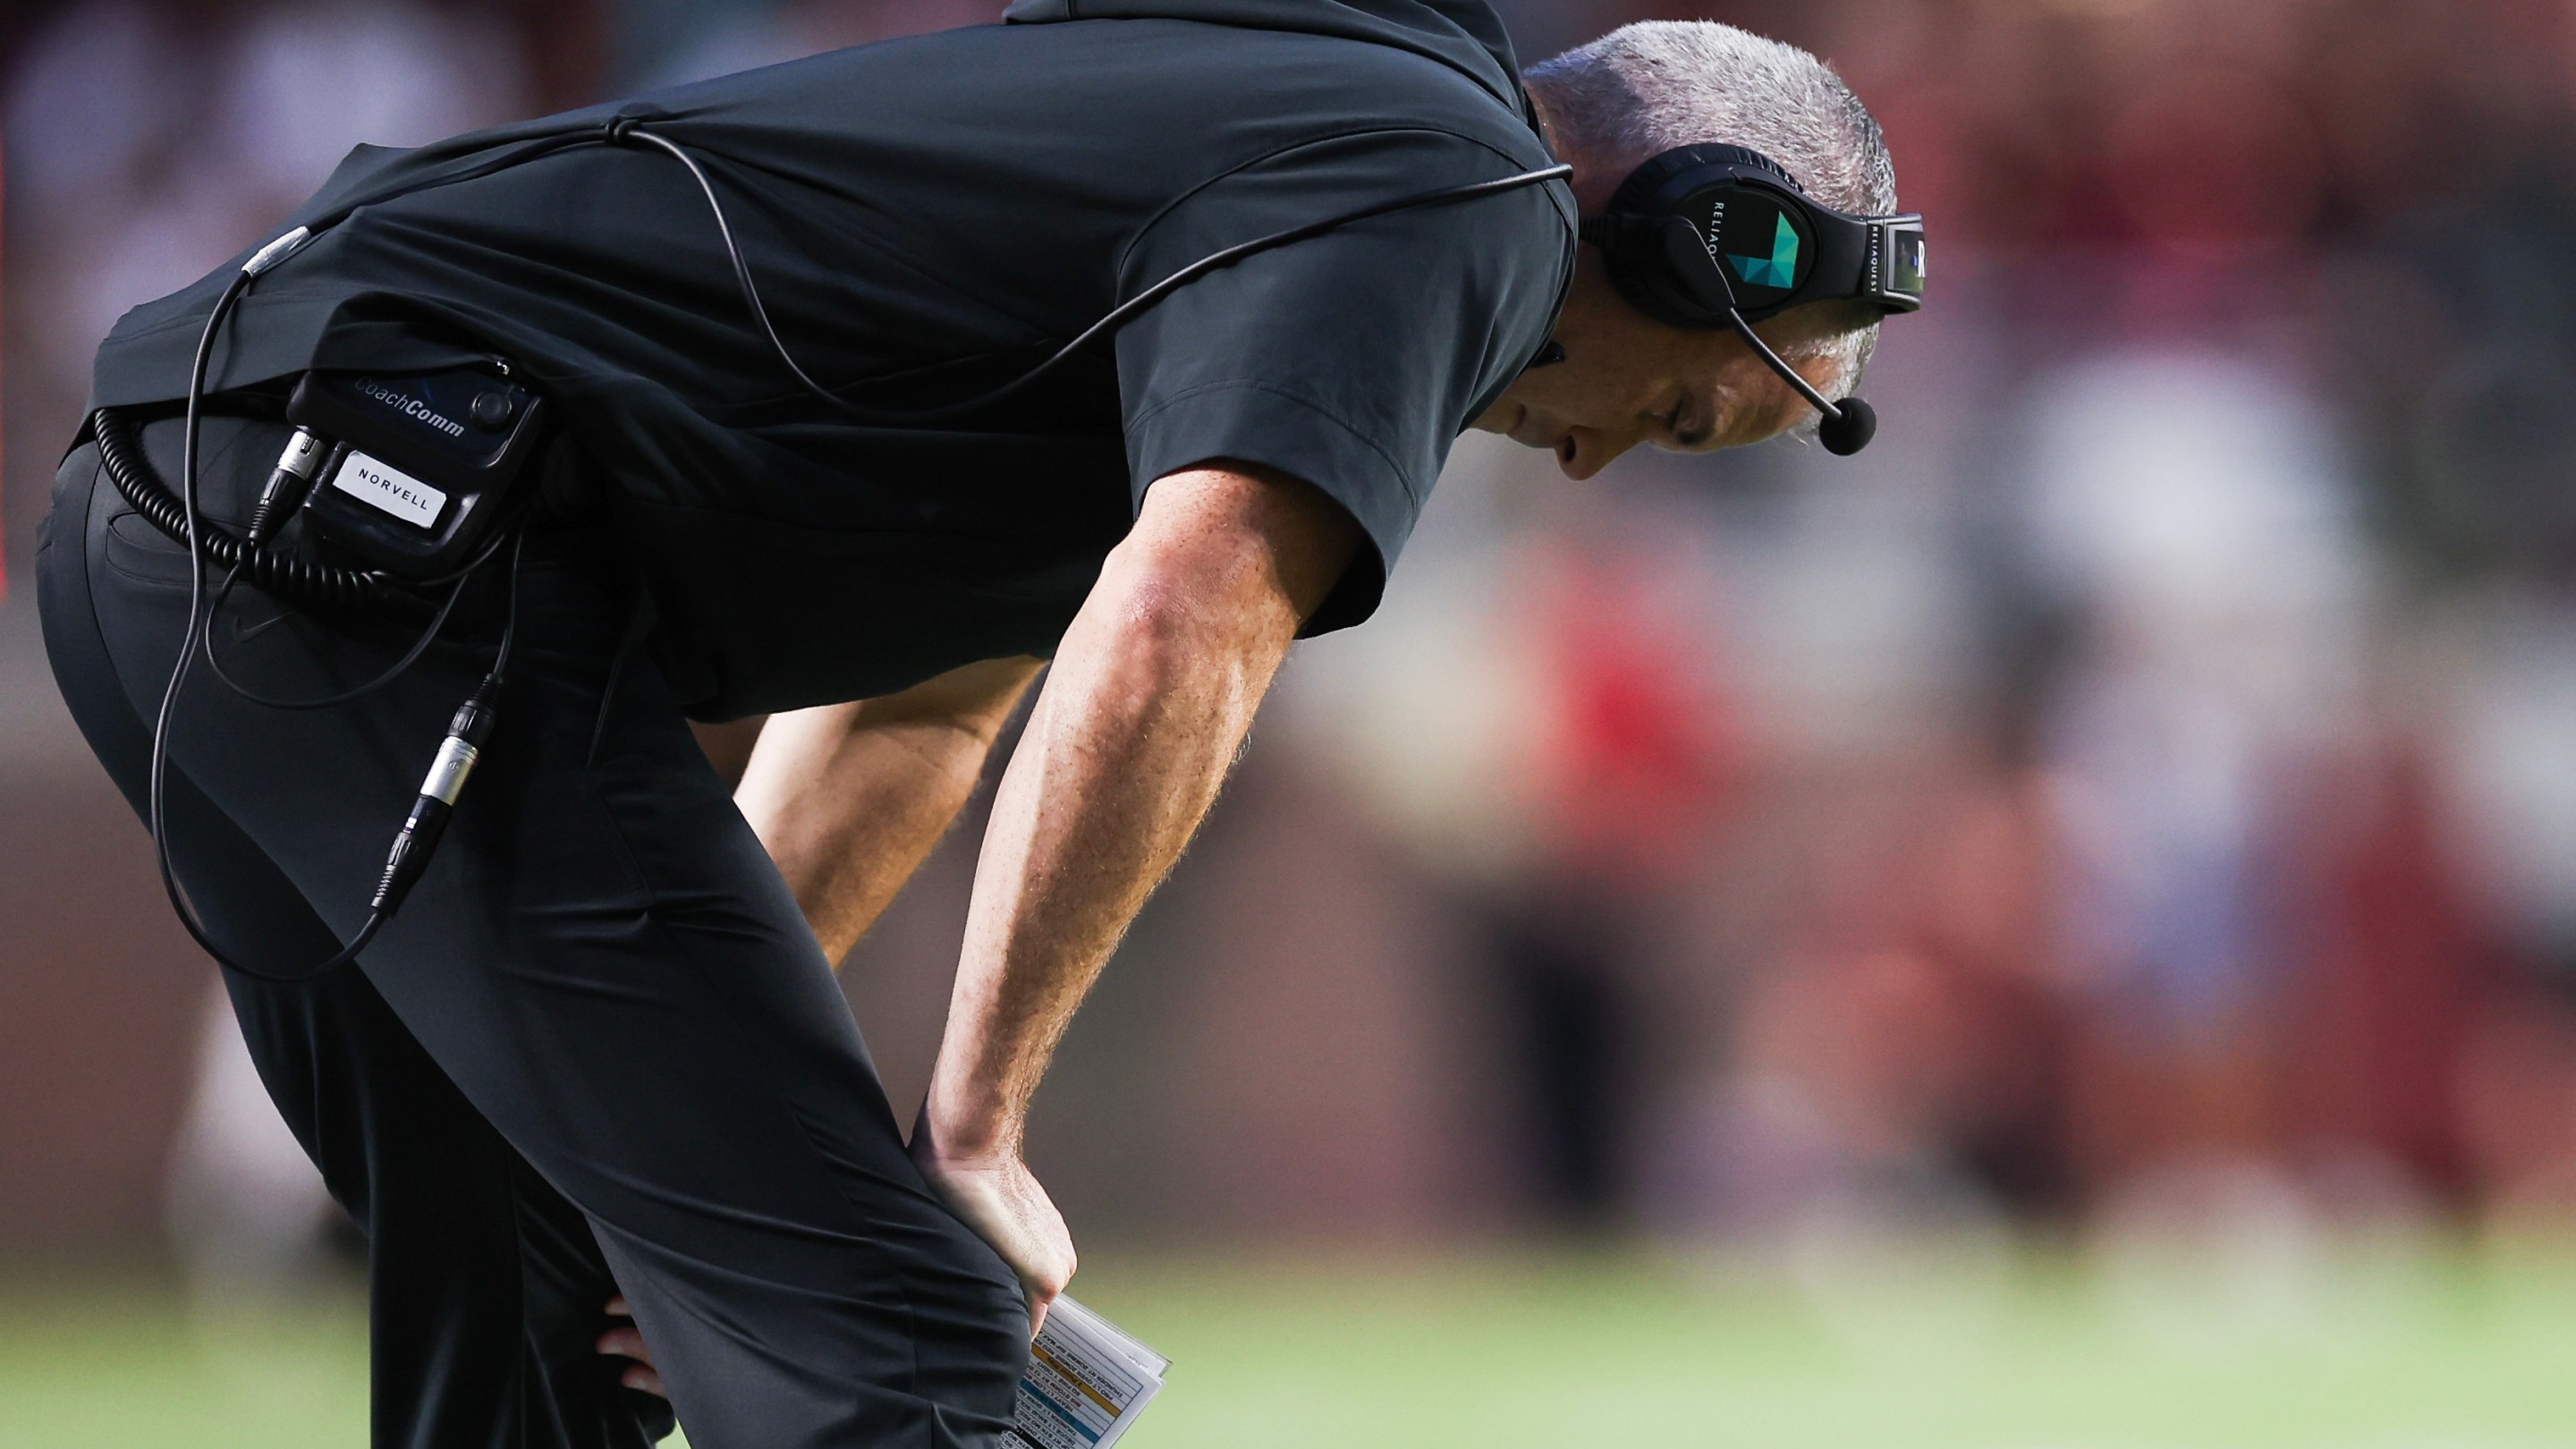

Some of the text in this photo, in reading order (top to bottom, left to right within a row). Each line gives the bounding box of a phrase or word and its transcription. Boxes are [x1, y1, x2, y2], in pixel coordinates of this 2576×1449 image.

[1707, 201, 1725, 259] RELIAQ
[1870, 225, 1879, 292] RELIAQUEST
[354, 376, 465, 437] CoachComm
[358, 467, 428, 511] NORVELL
[1041, 1333, 1056, 1346] MAX
[1036, 1360, 1055, 1376] TIGHT
[1054, 1352, 1078, 1373] ZOMBIE
[1065, 1351, 1089, 1371] ZOMBIE
[1031, 1377, 1046, 1391] LOW
[1075, 1369, 1093, 1385] OVER
[1095, 1375, 1123, 1398] THUNDER
[1048, 1381, 1071, 1400] STORM
[1099, 1388, 1114, 1401] PRO
[1025, 1394, 1043, 1410] OVER
[1053, 1394, 1073, 1412] HEAVY
[1048, 1412, 1078, 1436] THUNDER
